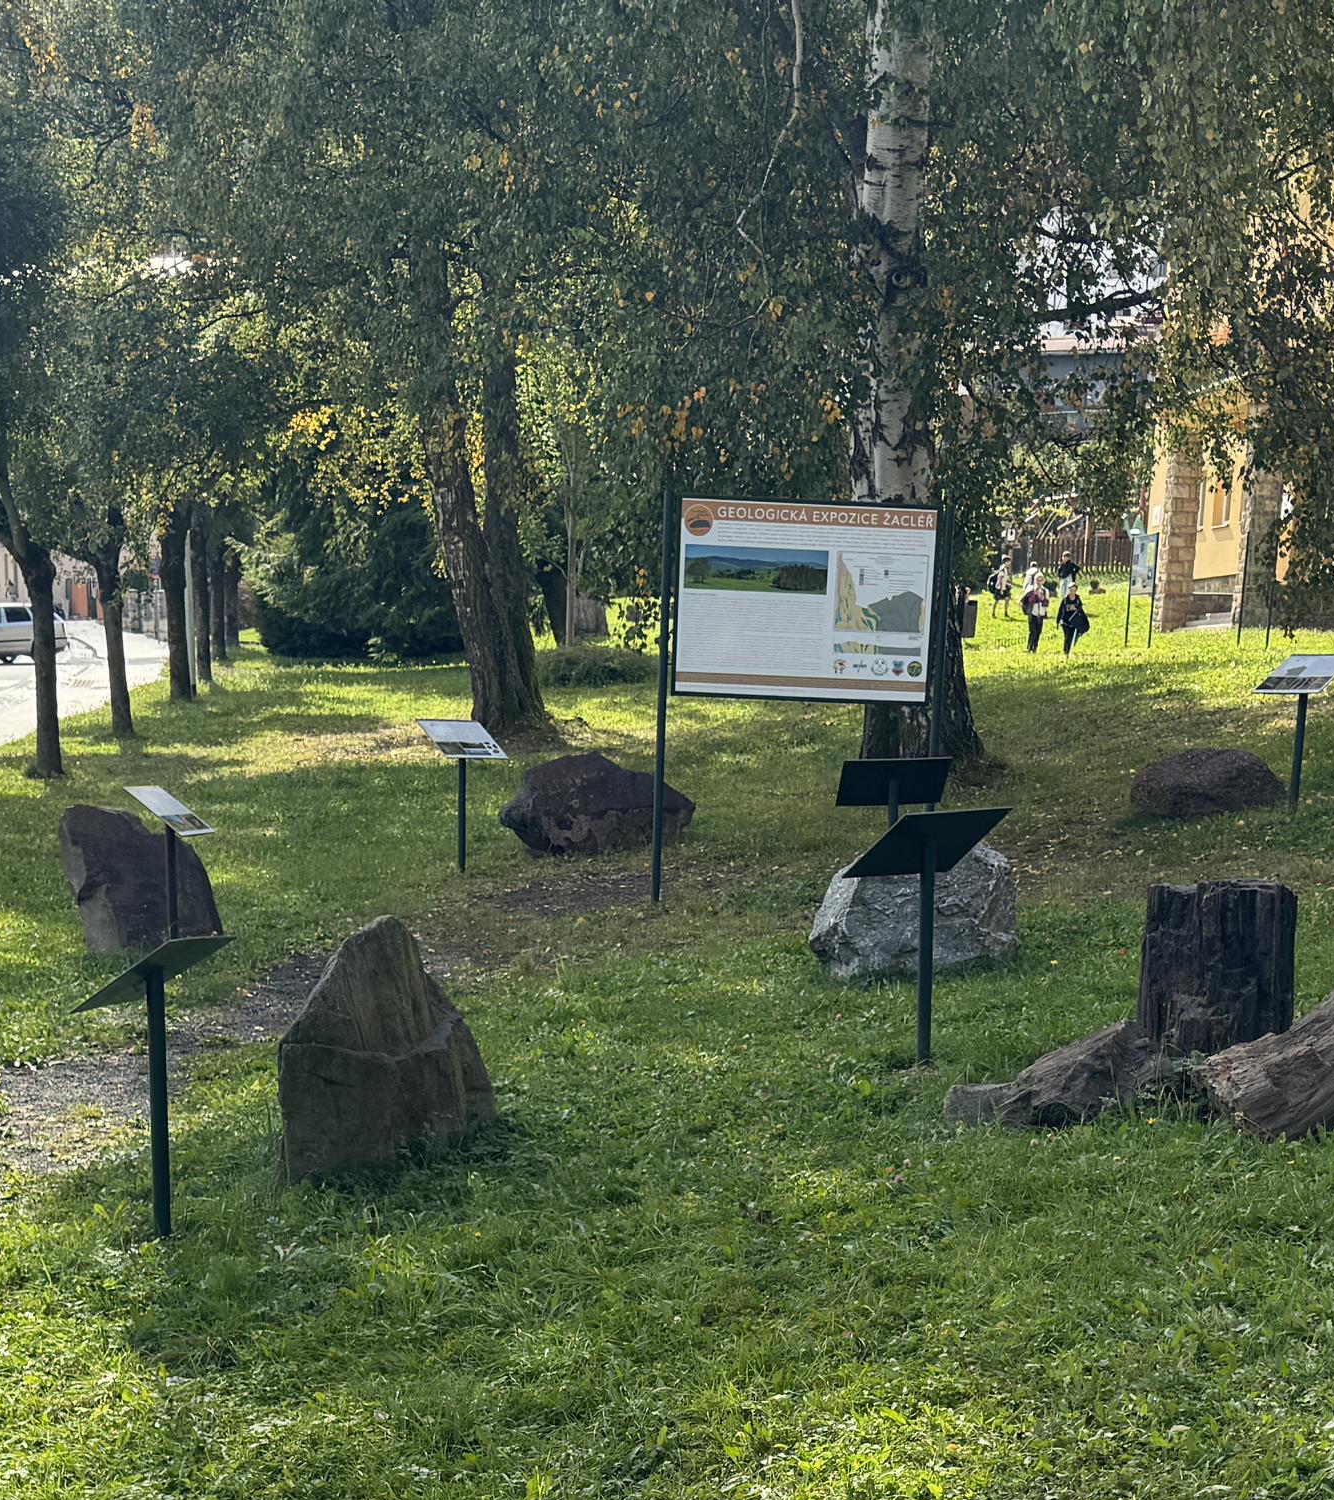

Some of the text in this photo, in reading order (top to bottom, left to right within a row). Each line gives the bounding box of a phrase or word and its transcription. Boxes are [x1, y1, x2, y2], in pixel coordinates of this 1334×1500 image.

[717, 506, 933, 528] GEOLOGICKÁ EXPOZICE ŽACLÉŘ
